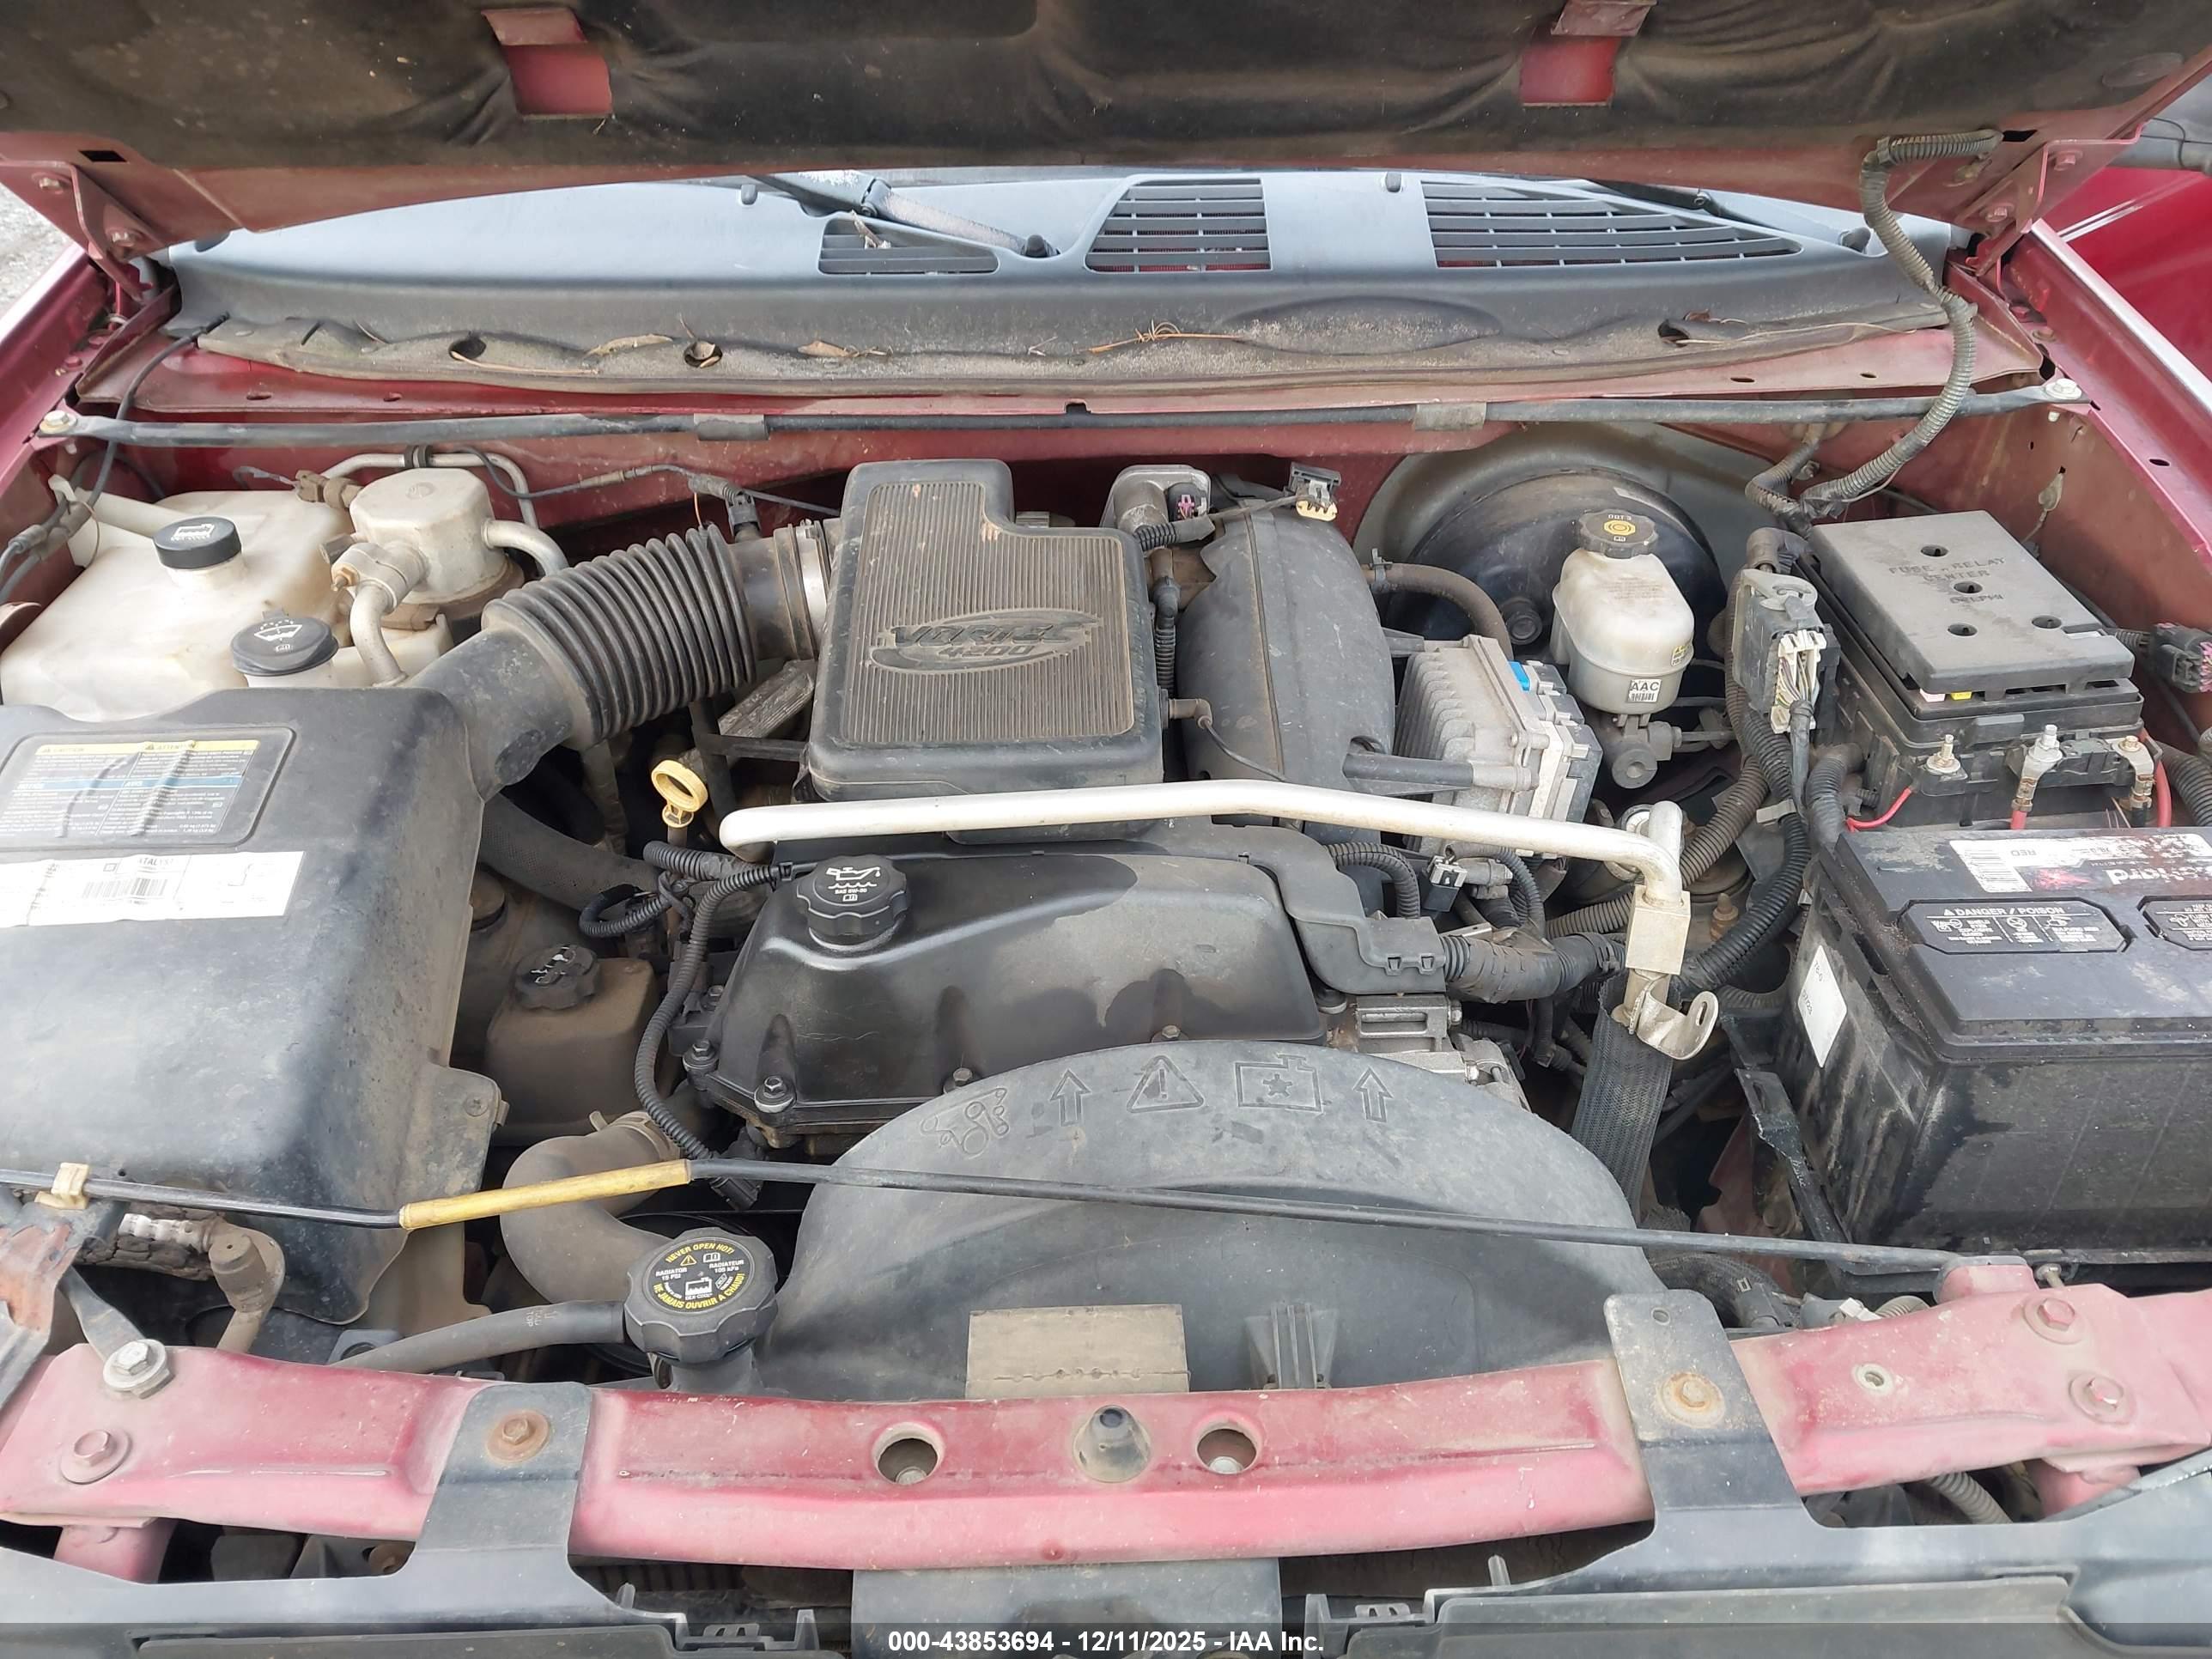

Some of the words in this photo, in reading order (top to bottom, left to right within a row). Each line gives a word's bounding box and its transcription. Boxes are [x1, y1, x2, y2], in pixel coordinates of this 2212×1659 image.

[1889, 565, 1934, 574] FUSE
[1951, 557, 2005, 569] RELAY
[1631, 681, 1660, 691] AAC
[1955, 908, 2006, 916] DANGER
[2017, 907, 2065, 915] POISON
[665, 1246, 692, 1262] NEVER
[692, 1243, 716, 1251] OPEN
[716, 1243, 735, 1254] HOT!
[709, 1260, 744, 1268] RADIATEUR
[655, 1267, 688, 1276] RADIATOR
[658, 1291, 685, 1309] JAMAIS
[685, 1297, 719, 1310] OUVRIR
[723, 1273, 745, 1297] CHAUD!
